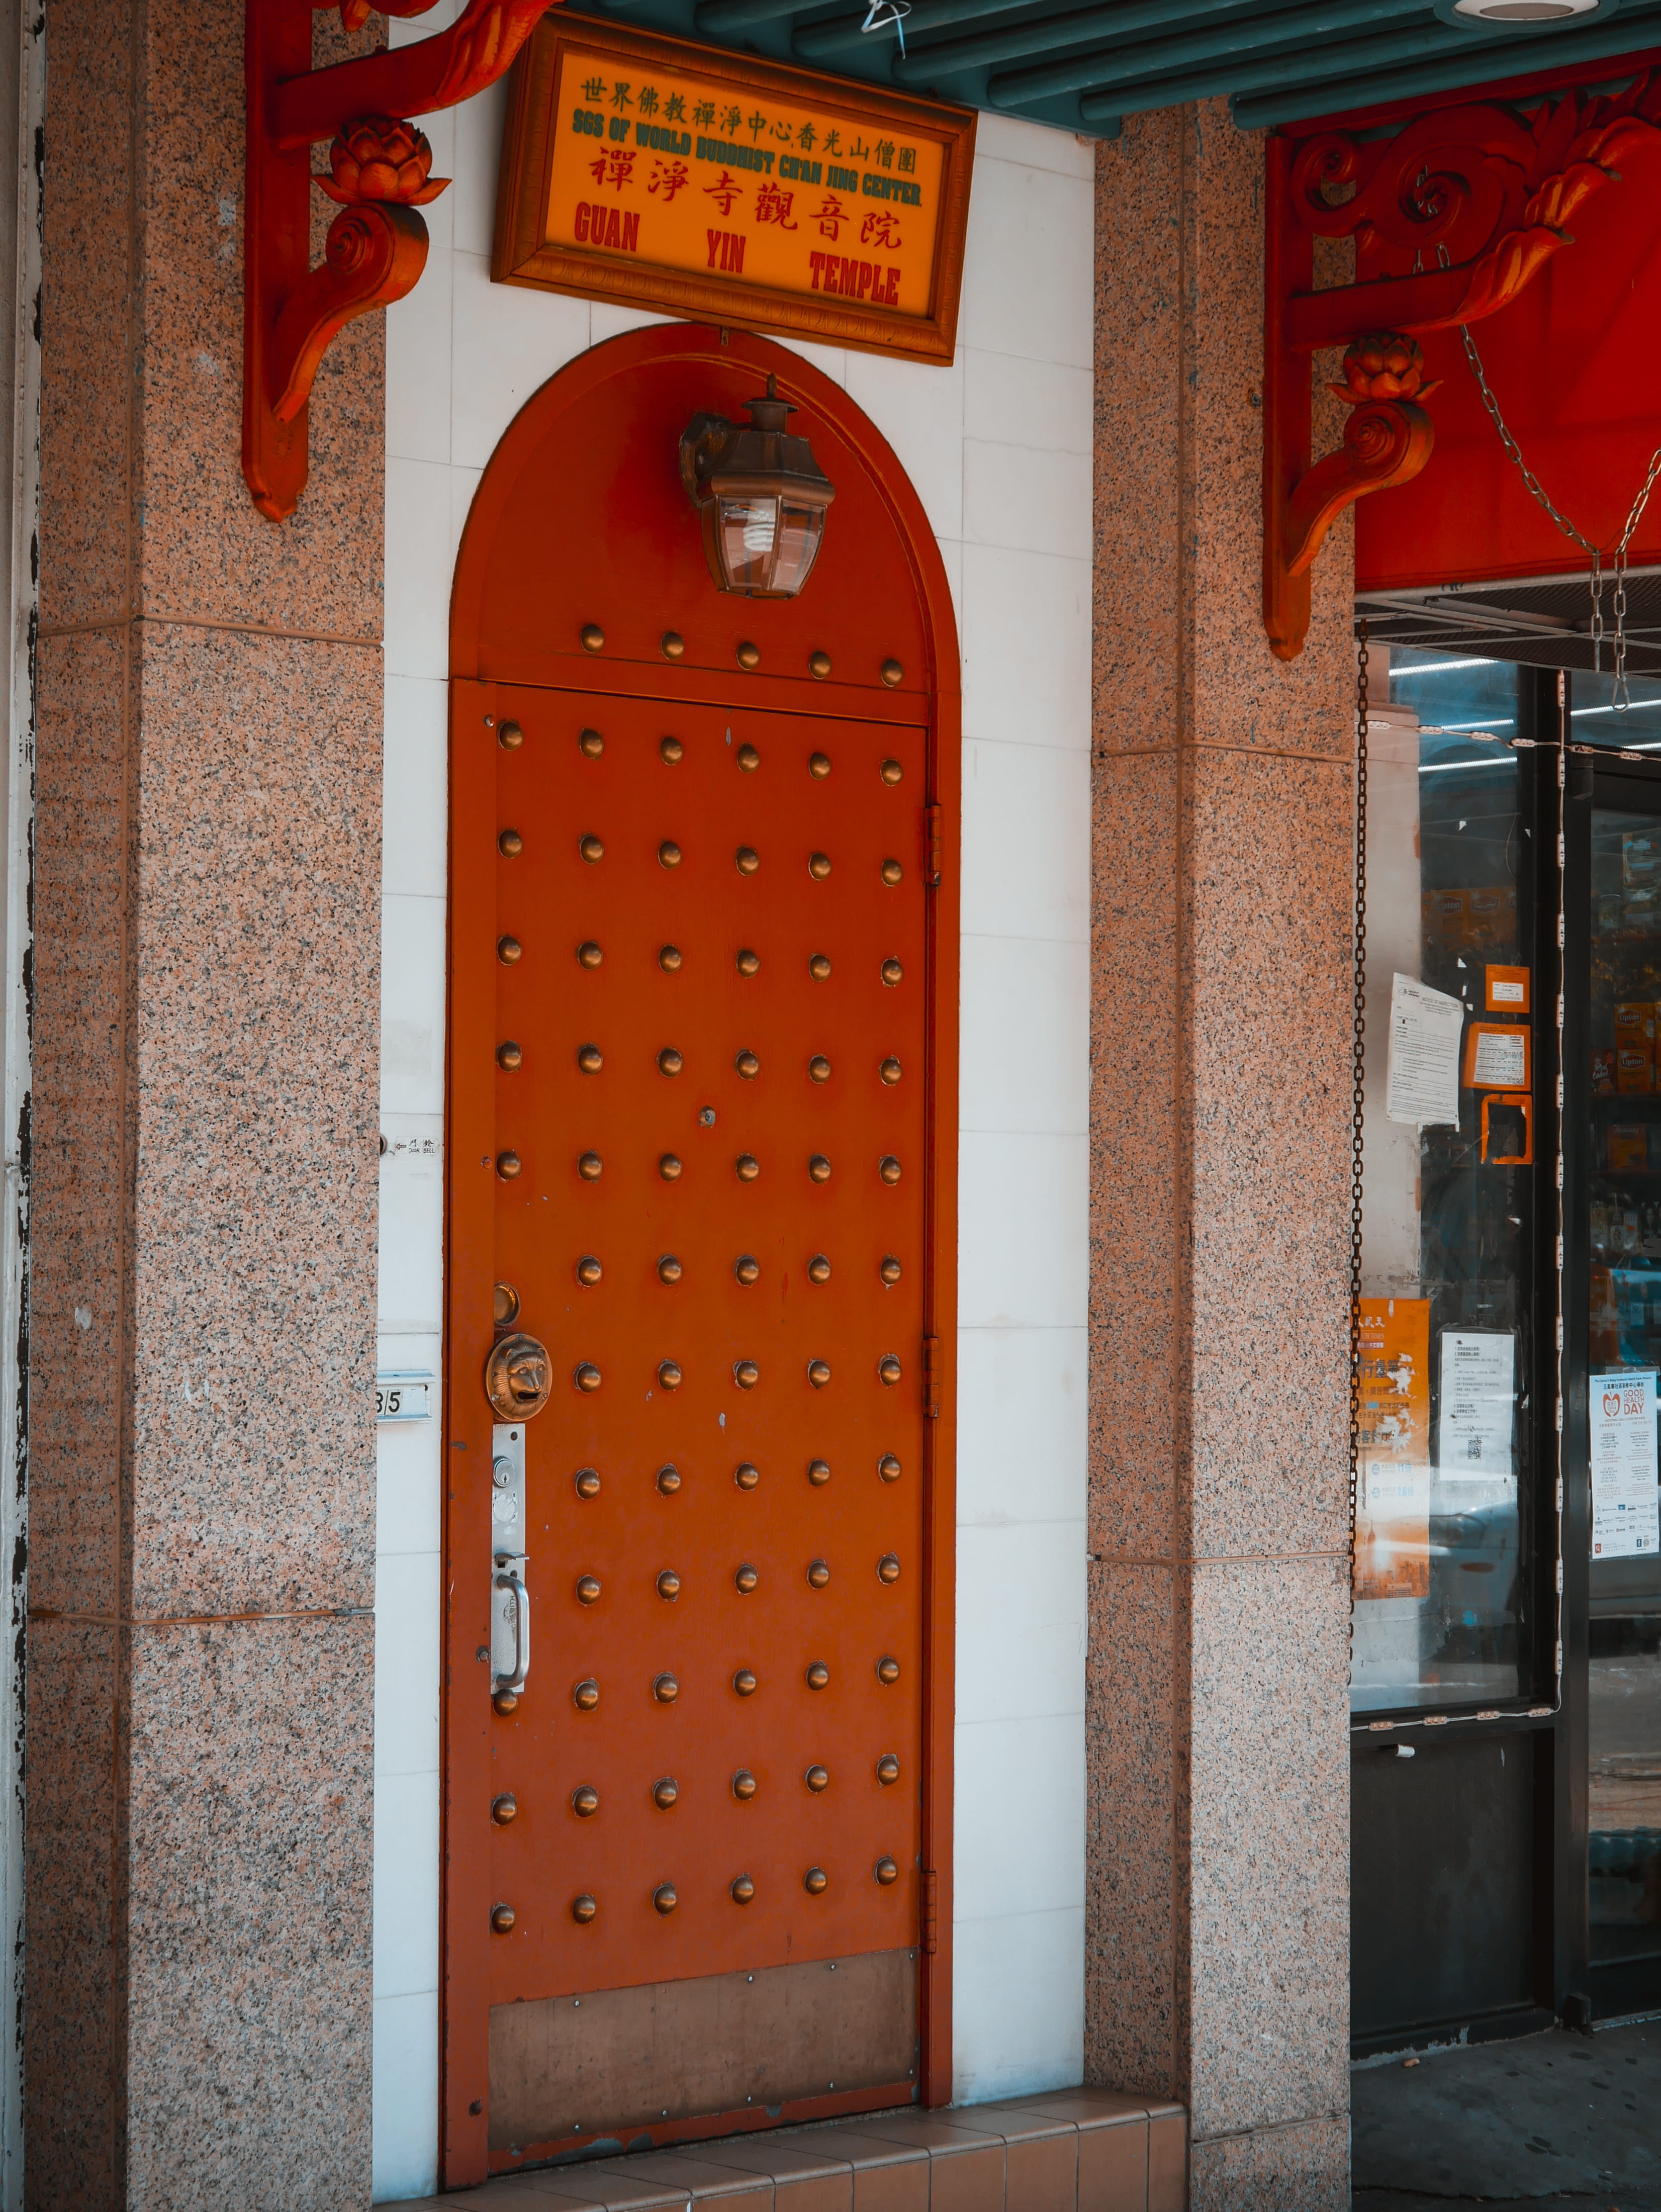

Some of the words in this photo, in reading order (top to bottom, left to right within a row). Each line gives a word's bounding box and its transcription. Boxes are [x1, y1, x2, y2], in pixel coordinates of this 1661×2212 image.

[573, 109, 605, 137] SGS
[609, 116, 631, 143] OF
[636, 122, 691, 156] WORLD
[696, 136, 775, 174] BUDDHIST
[779, 154, 822, 185] CH'AN
[826, 165, 859, 193] JING
[589, 146, 902, 248] 禪淨寺觀音院
[574, 202, 640, 252] GUAN
[707, 228, 747, 274] YIN
[809, 251, 901, 306] TEMPLE
[1619, 1013, 1639, 1022] Lipton
[1622, 1057, 1643, 1066] Lipton
[1624, 1389, 1644, 1397] GOOD
[1624, 1403, 1644, 1415] DAY
